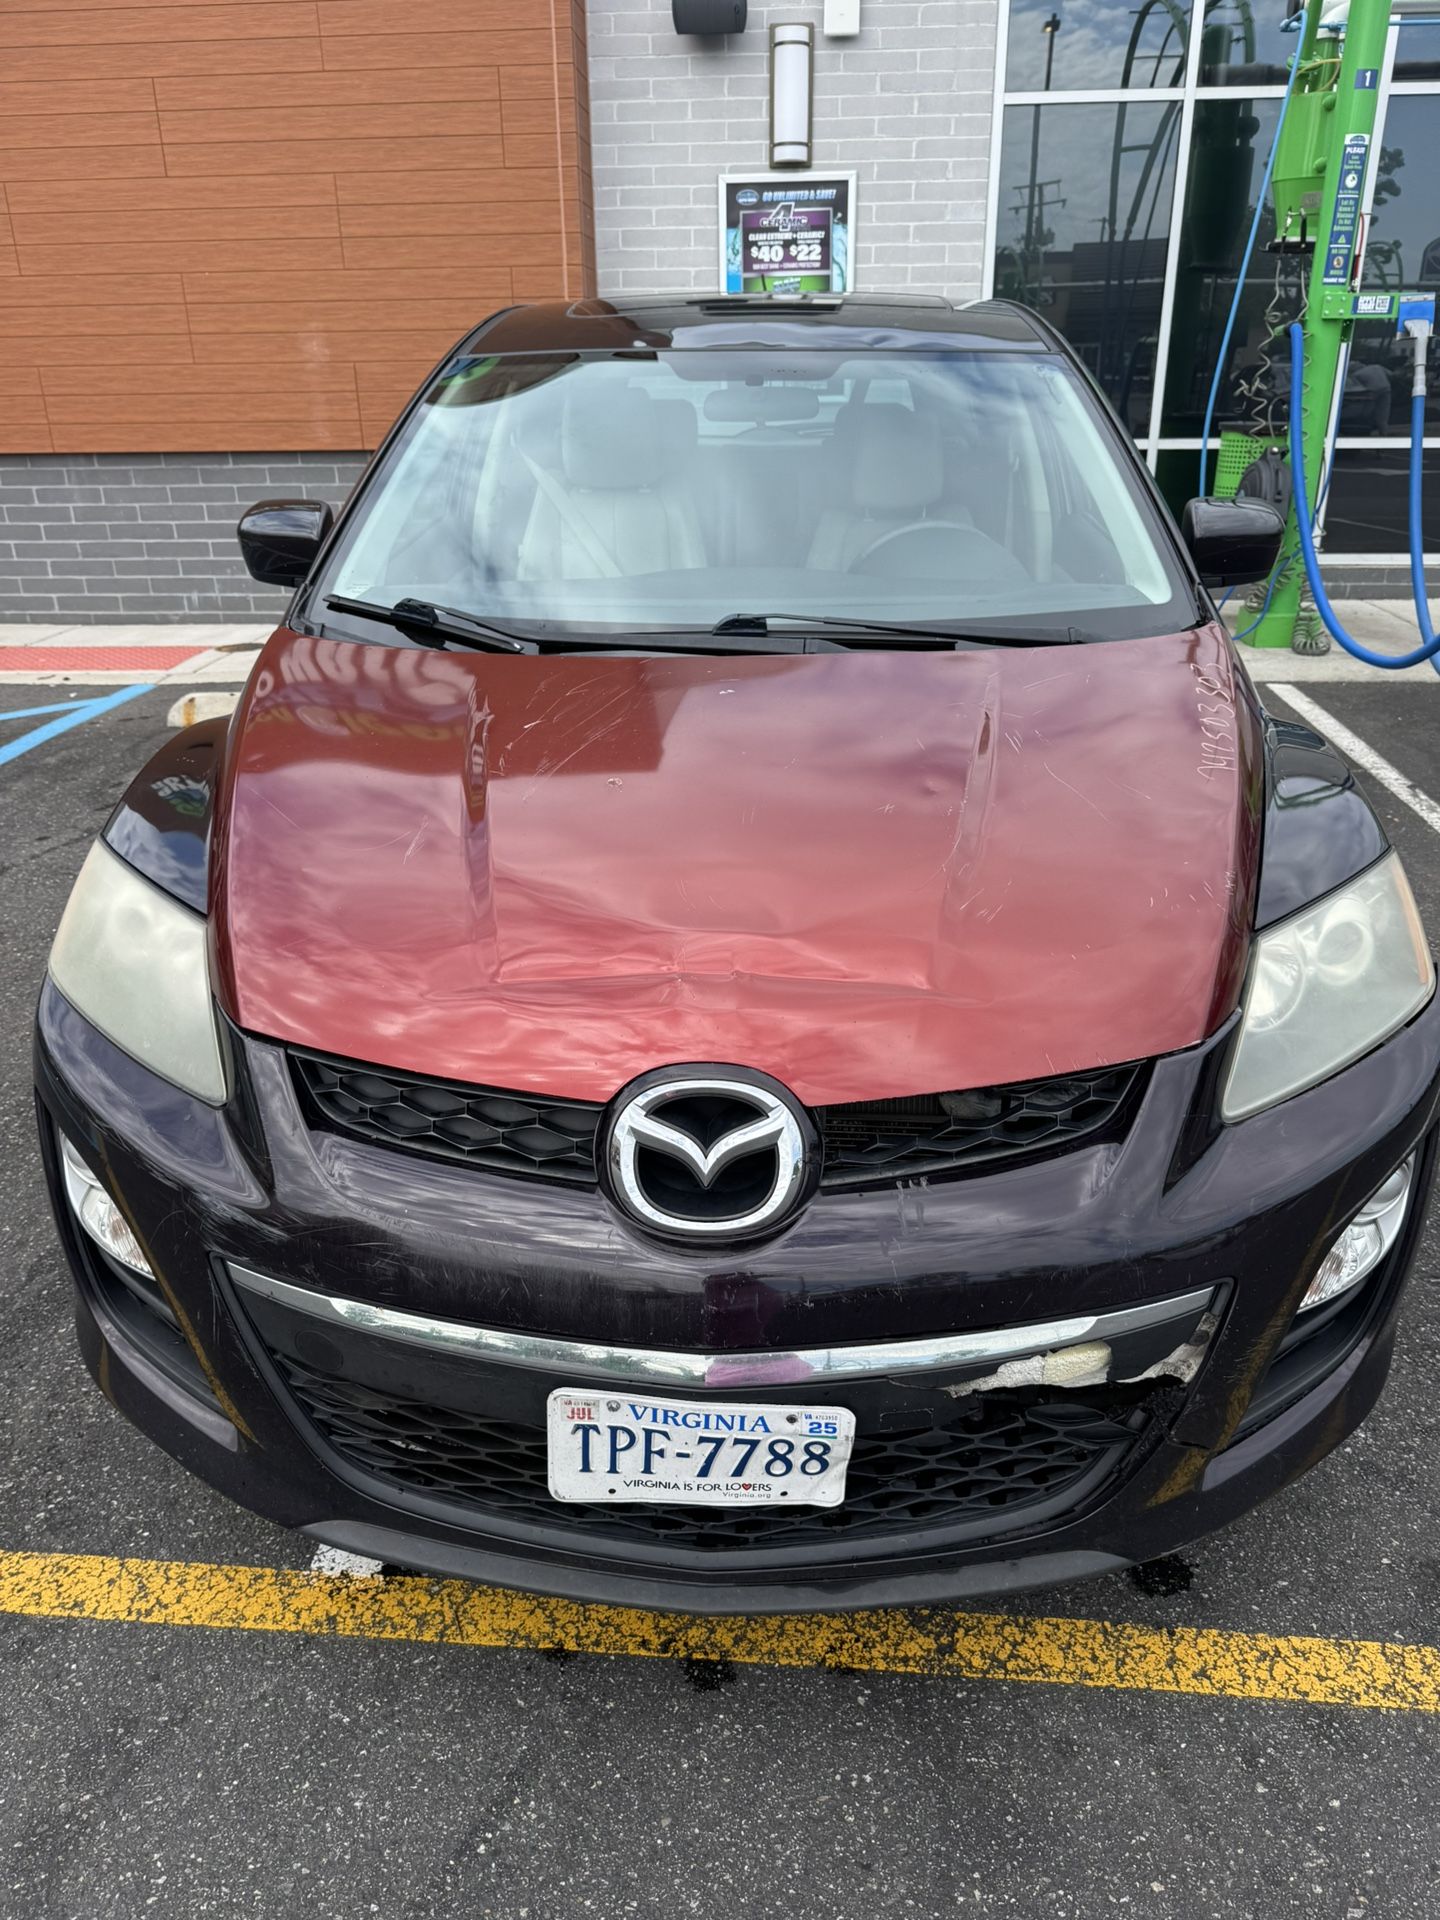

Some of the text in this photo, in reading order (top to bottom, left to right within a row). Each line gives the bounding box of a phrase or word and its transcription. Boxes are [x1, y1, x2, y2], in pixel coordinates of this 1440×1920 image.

[1365, 70, 1371, 87] 1
[760, 216, 808, 228] CERAMIC
[750, 244, 822, 262] $40 $22
[566, 1407, 595, 1420] JUL
[628, 1404, 773, 1434] VIRGINIA
[809, 1421, 838, 1434] 25
[571, 1424, 831, 1479] TPF-7788
[623, 1479, 681, 1491] VIRGINIA
[684, 1481, 693, 1491] IS
[697, 1483, 722, 1491] FOR
[723, 1491, 771, 1499] Virginia.org
